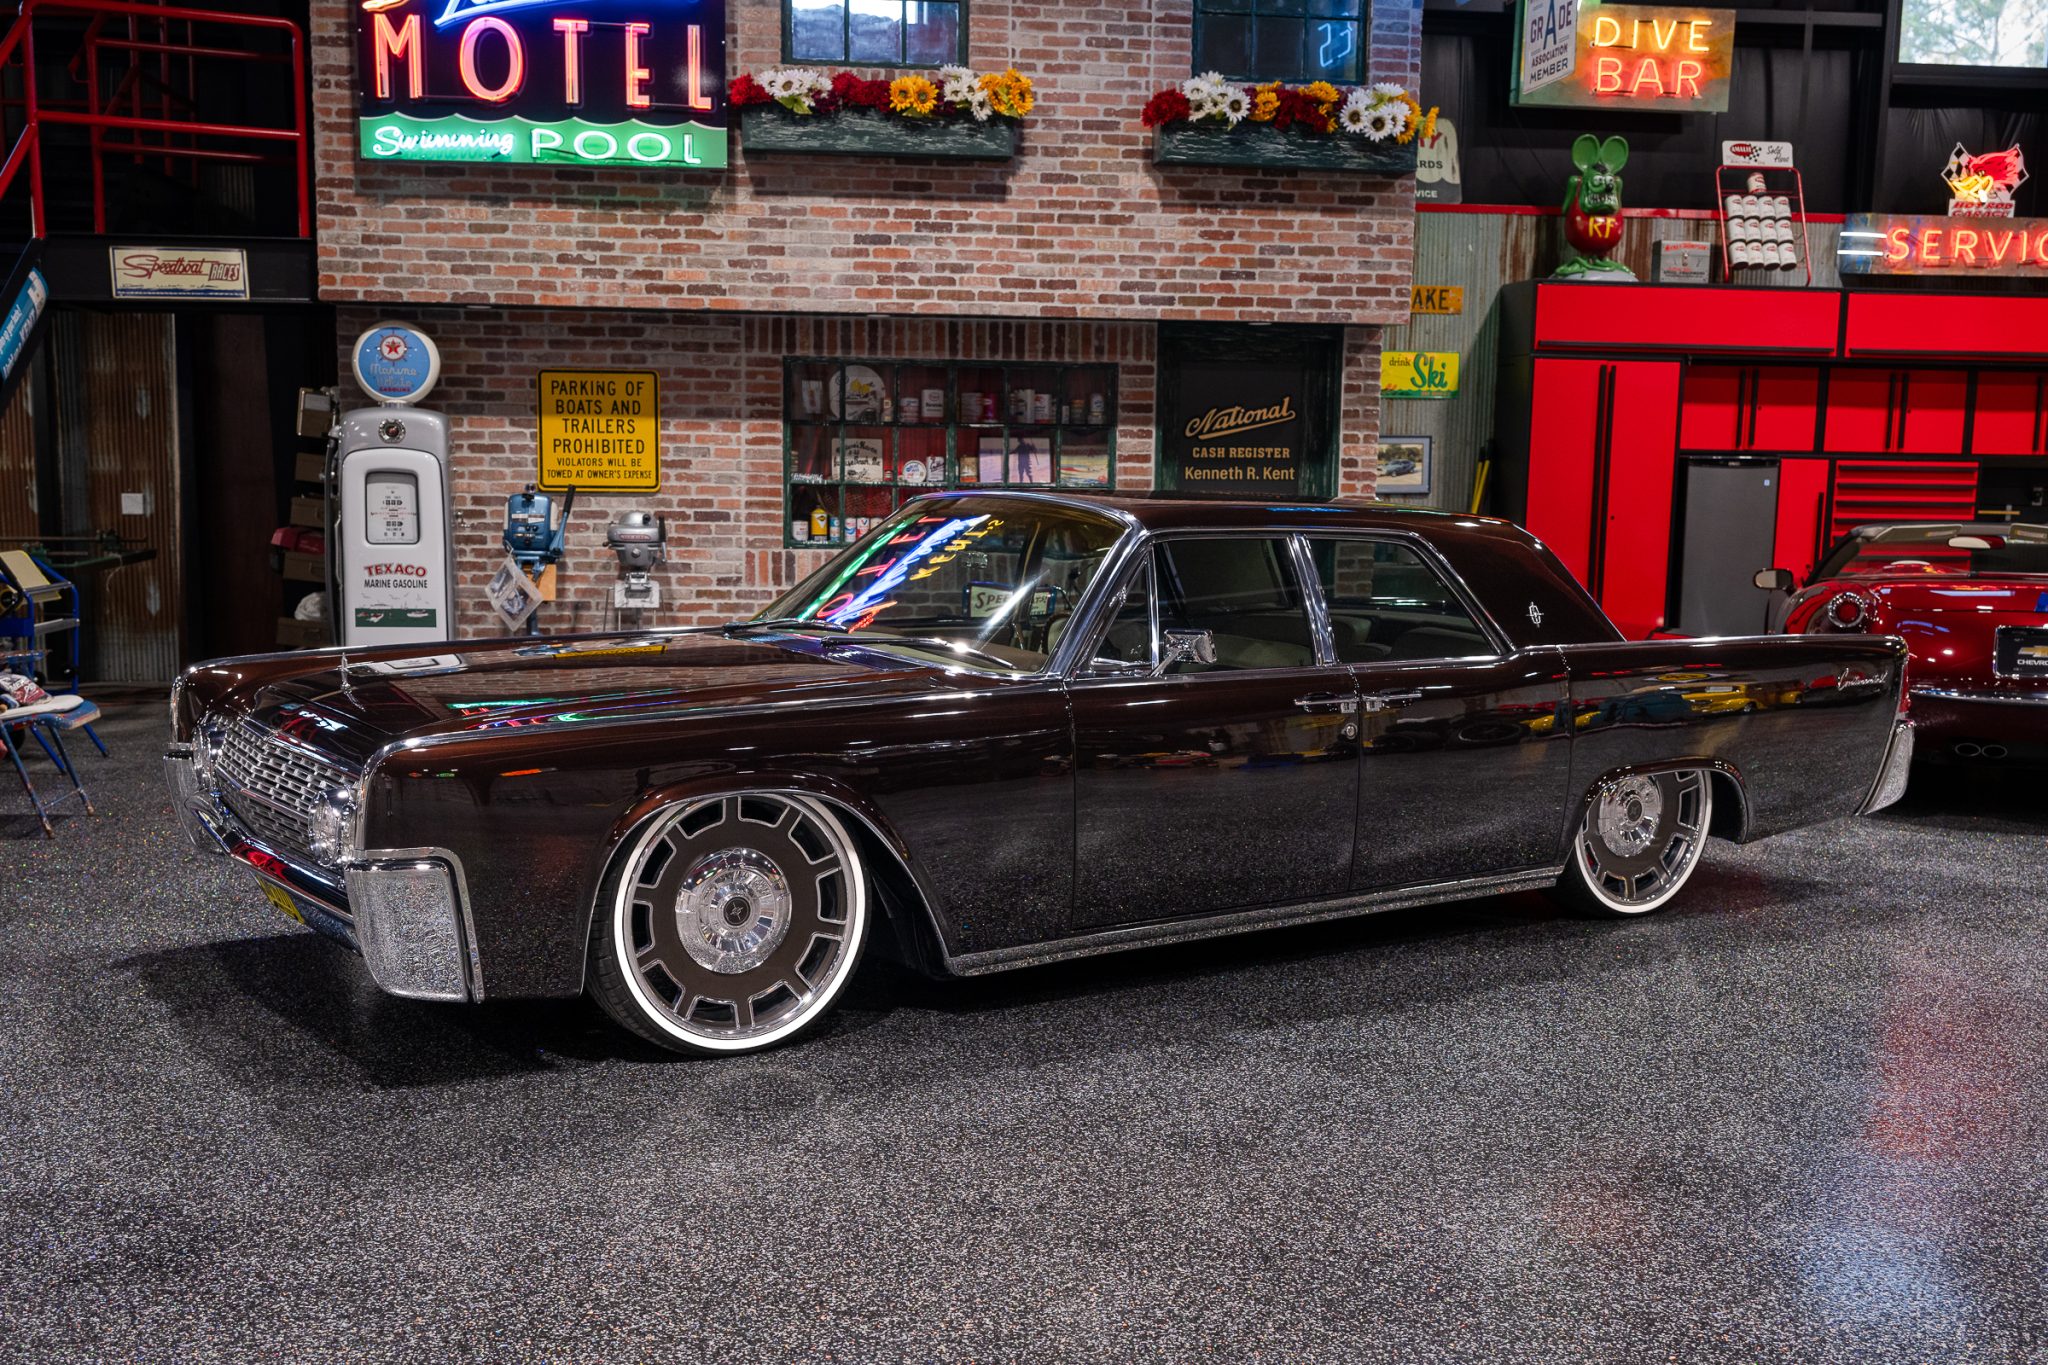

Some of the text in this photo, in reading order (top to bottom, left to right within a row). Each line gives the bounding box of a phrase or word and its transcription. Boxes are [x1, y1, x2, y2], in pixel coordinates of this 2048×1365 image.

[1594, 16, 1712, 52] DIVE
[374, 14, 711, 110] MOTEL
[1531, 43, 1568, 68] ASSOCIATION
[1529, 58, 1568, 84] MEMBER
[1595, 57, 1702, 97] BAR
[373, 126, 702, 165] Swimming POOL
[122, 254, 240, 281] Speedboat RACES
[370, 363, 417, 376] Marine
[1389, 353, 1448, 389] drink Ski
[551, 380, 645, 396] PARKING OF
[556, 399, 641, 415] BOATS AND
[1185, 396, 1296, 439] National
[562, 418, 636, 434] TRAILERS
[553, 438, 645, 454] PROHIBITED
[1192, 447, 1290, 459] CASH REGISTER
[557, 458, 642, 467] VIOLATORS WILL BE
[547, 469, 652, 479] TOWED AT OWNER'S EXPENSE
[1185, 466, 1295, 480] Kenneth R. Kent
[364, 563, 427, 577] TEXACO
[364, 579, 428, 588] MARINE GASOLINE
